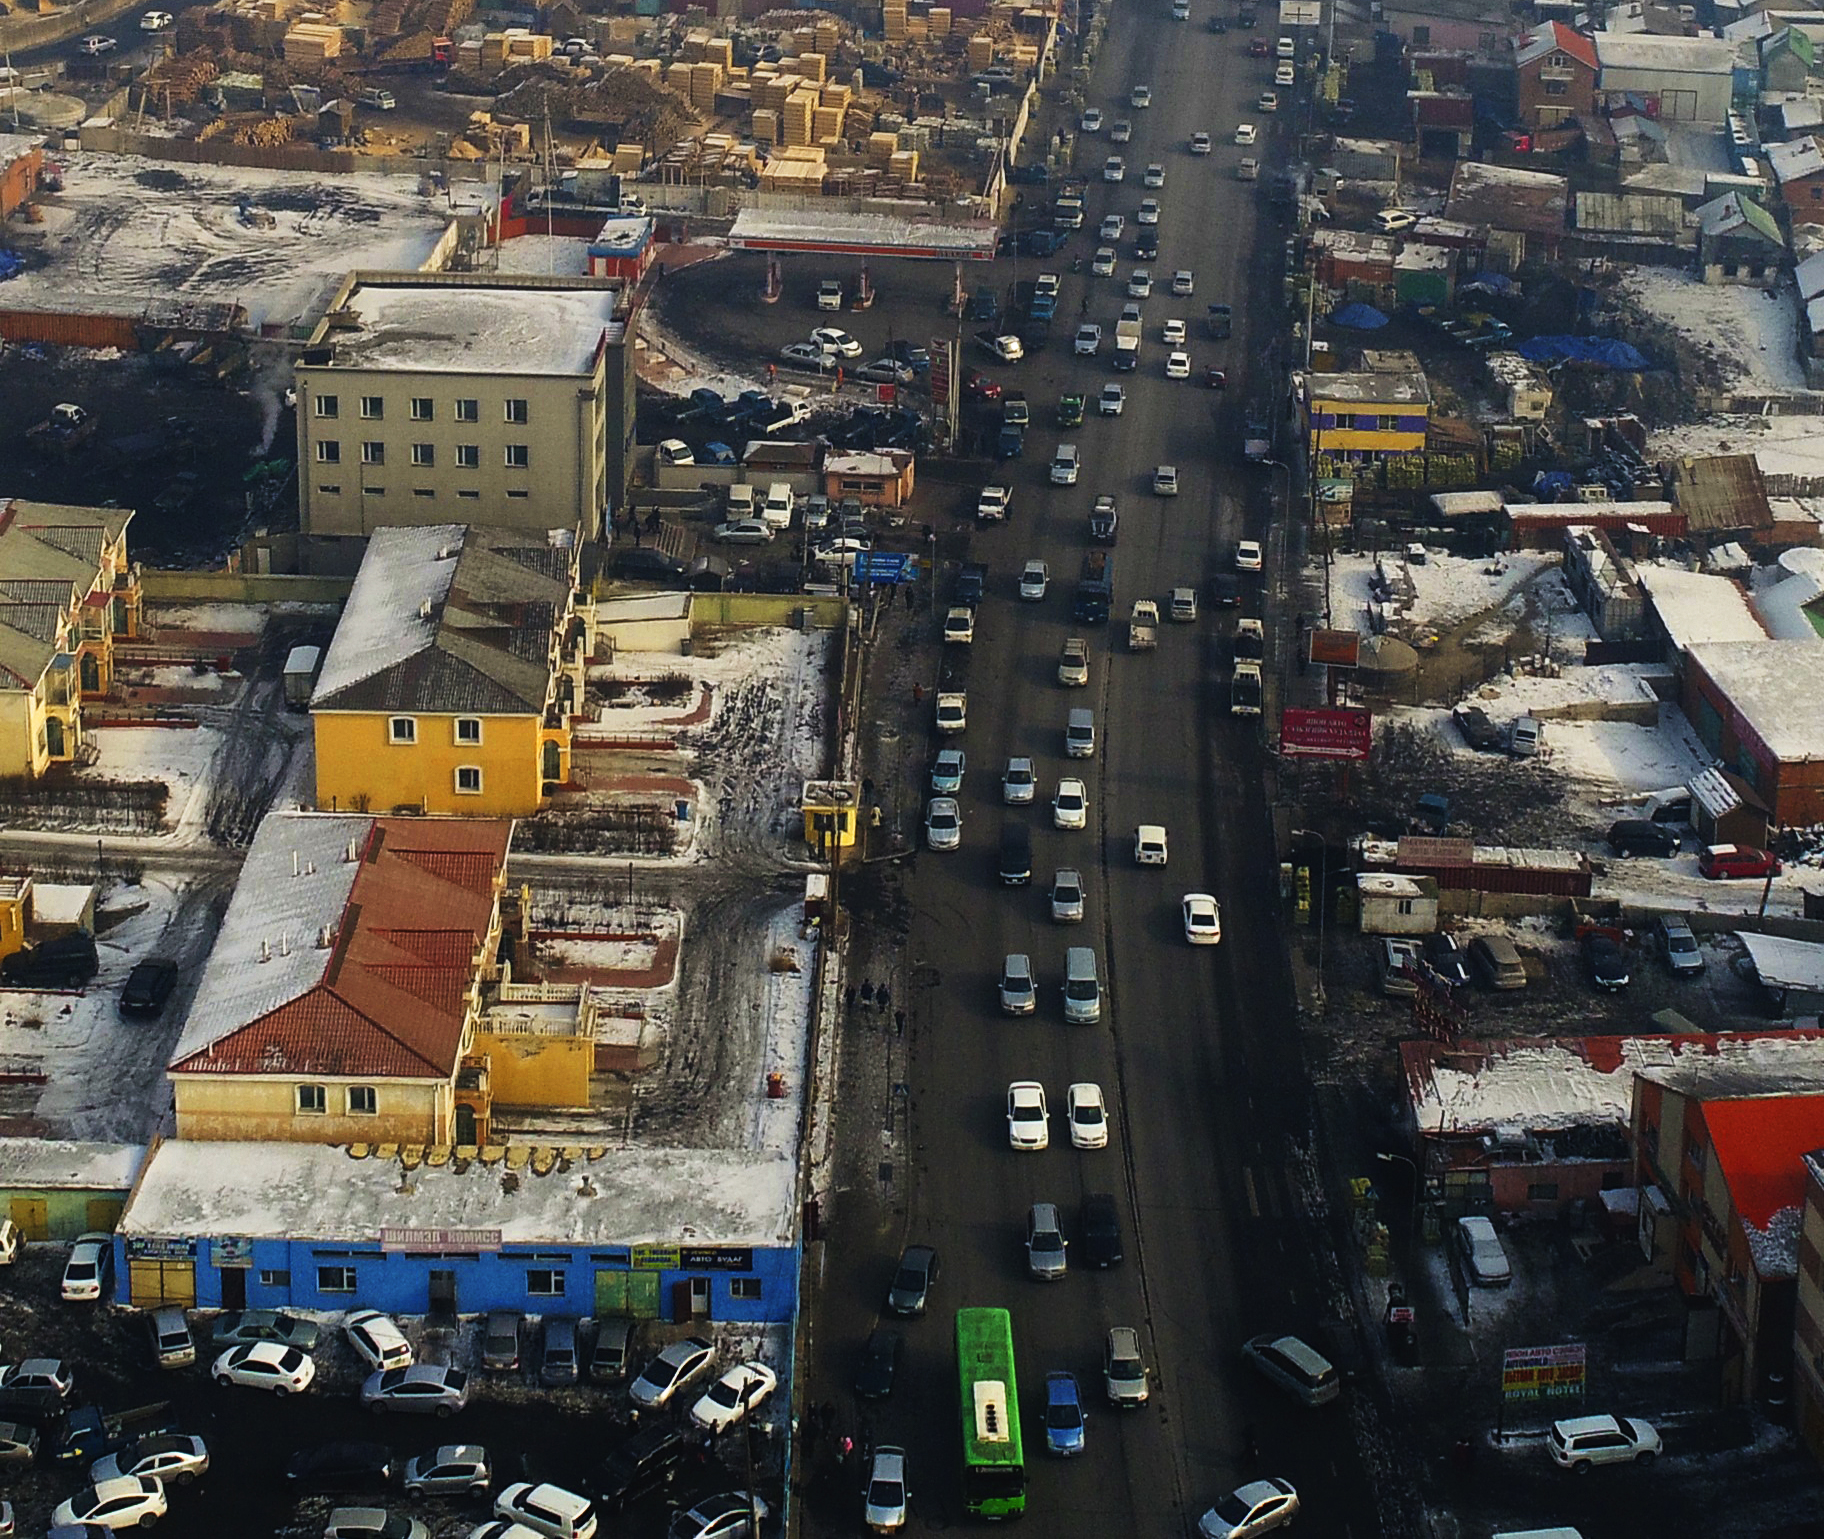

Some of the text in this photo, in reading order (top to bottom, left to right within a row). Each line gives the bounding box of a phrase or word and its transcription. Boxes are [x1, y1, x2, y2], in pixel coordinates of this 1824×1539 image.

[447, 1228, 499, 1244] КОМИСС
[717, 1255, 743, 1263] БУДАГ
[1505, 1385, 1580, 1398] ROYAL HOTEL
